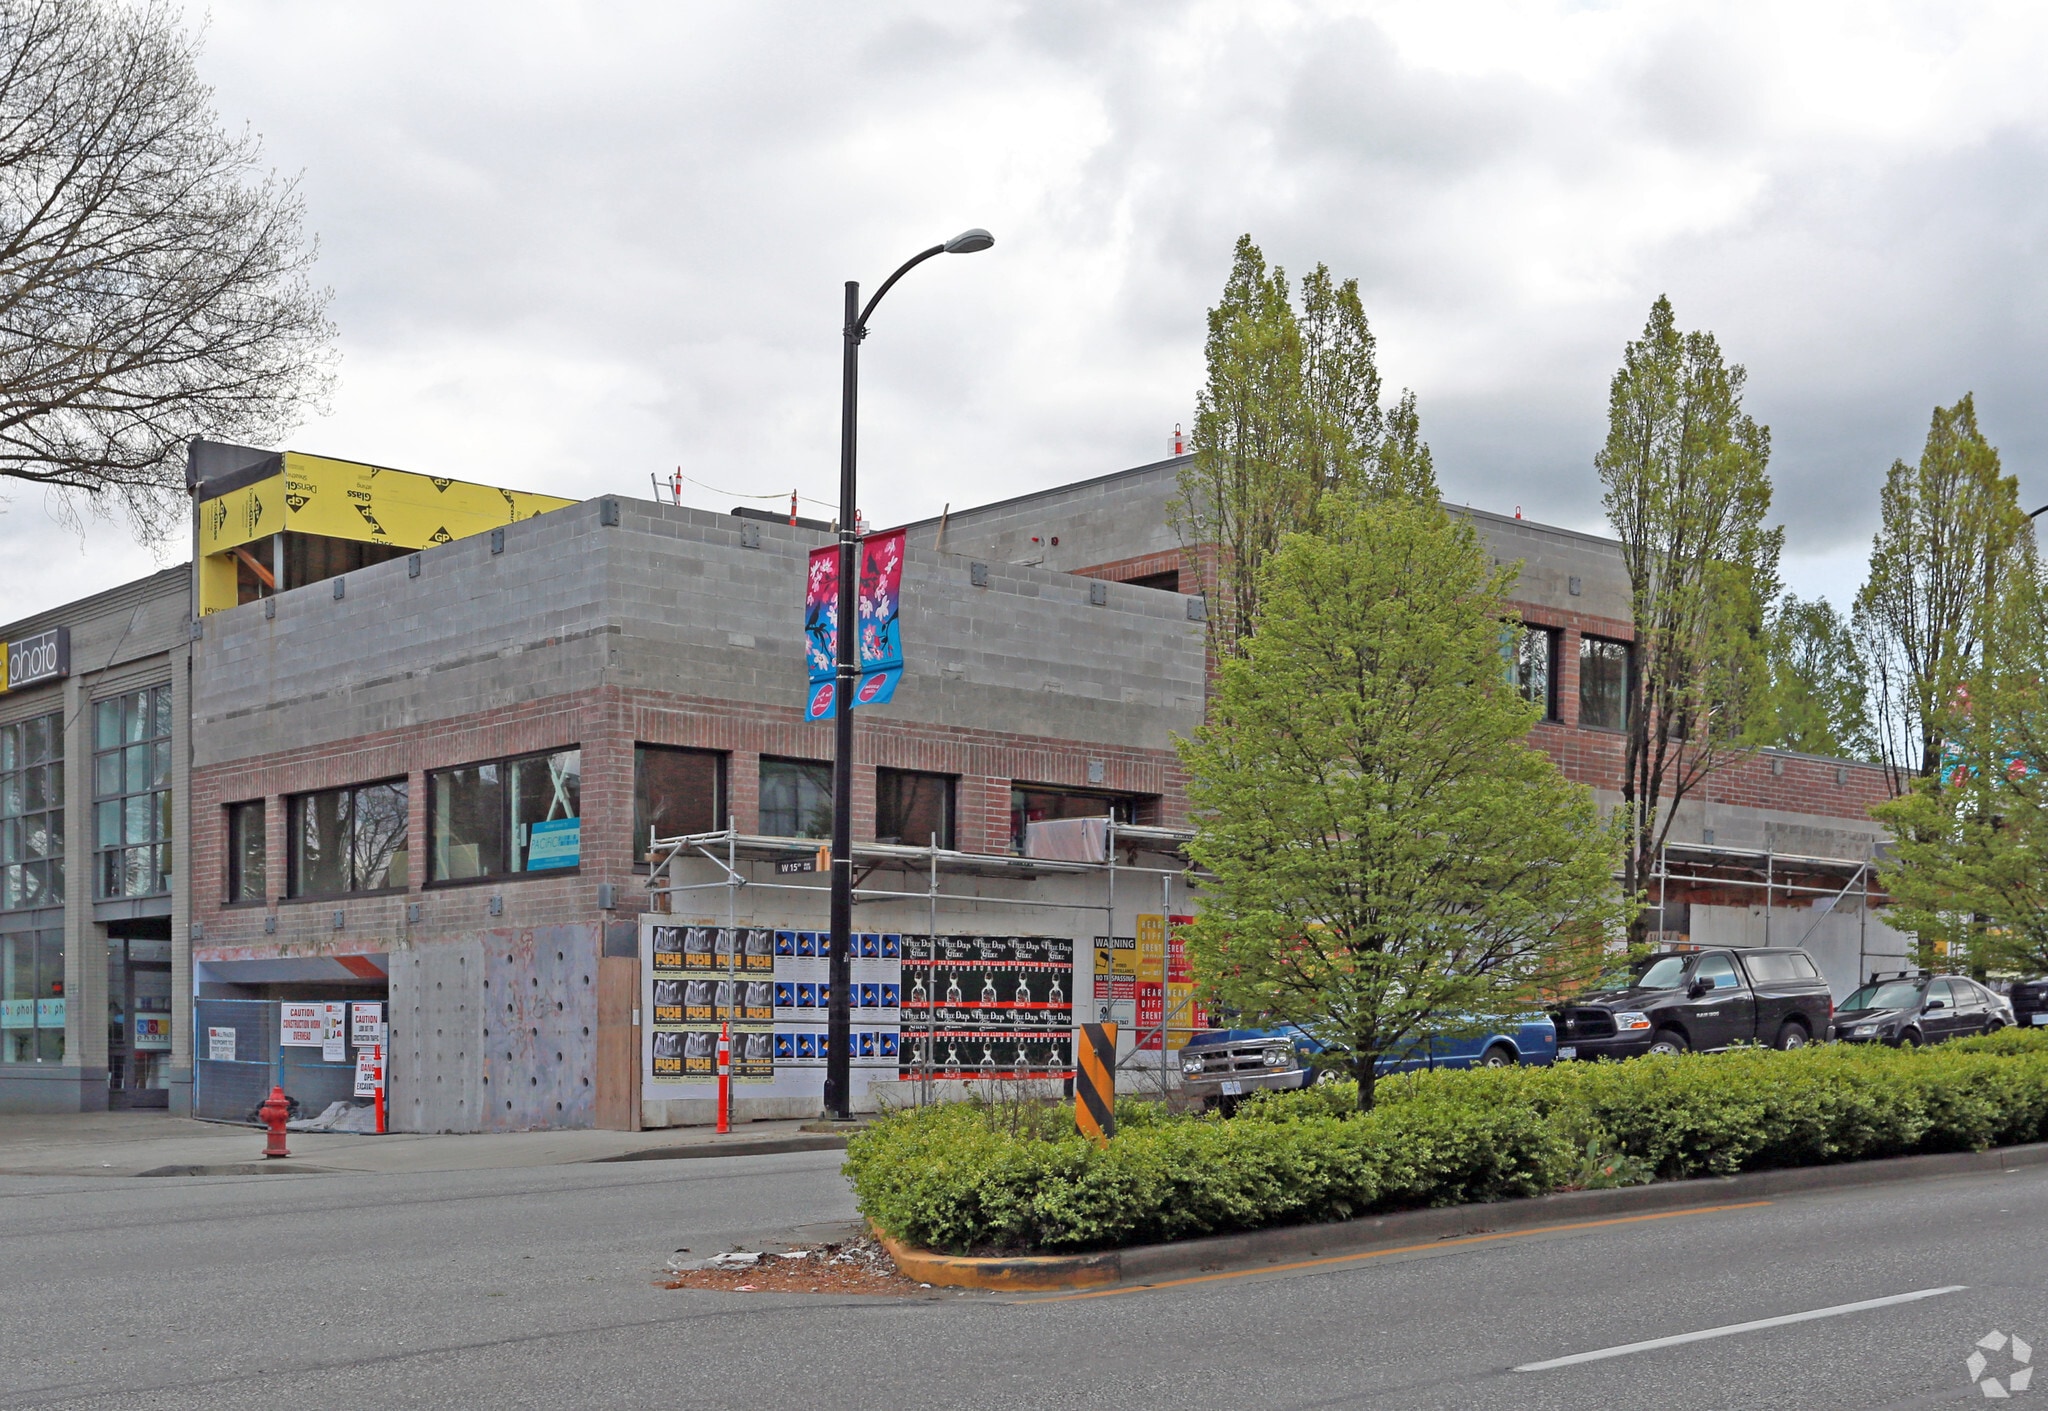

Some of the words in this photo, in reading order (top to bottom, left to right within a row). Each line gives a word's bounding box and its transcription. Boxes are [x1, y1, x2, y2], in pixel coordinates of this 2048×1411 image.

[434, 533, 450, 543] GP
[10, 635, 57, 685] photo
[781, 863, 789, 872] W
[1141, 920, 1162, 929] HEAR
[1141, 932, 1162, 940] DIFF
[956, 940, 971, 952] Days
[992, 940, 1006, 952] Days
[1026, 941, 1040, 953] Days
[1059, 943, 1072, 954] Days
[1141, 944, 1162, 952] ERENT
[716, 954, 741, 966] FUE
[1103, 974, 1135, 982] TRSPASSING
[1141, 988, 1162, 997] HEAR
[1141, 1000, 1162, 1008] DIFF
[290, 1008, 315, 1017] CAUTION
[716, 1007, 741, 1018] FUE
[1141, 1012, 1162, 1020] ERENT
[283, 1019, 309, 1029] CONSTRUCTION
[355, 1015, 378, 1024] CAUTION
[137, 1034, 169, 1042] photo
[293, 1031, 311, 1041] OVERHEAD
